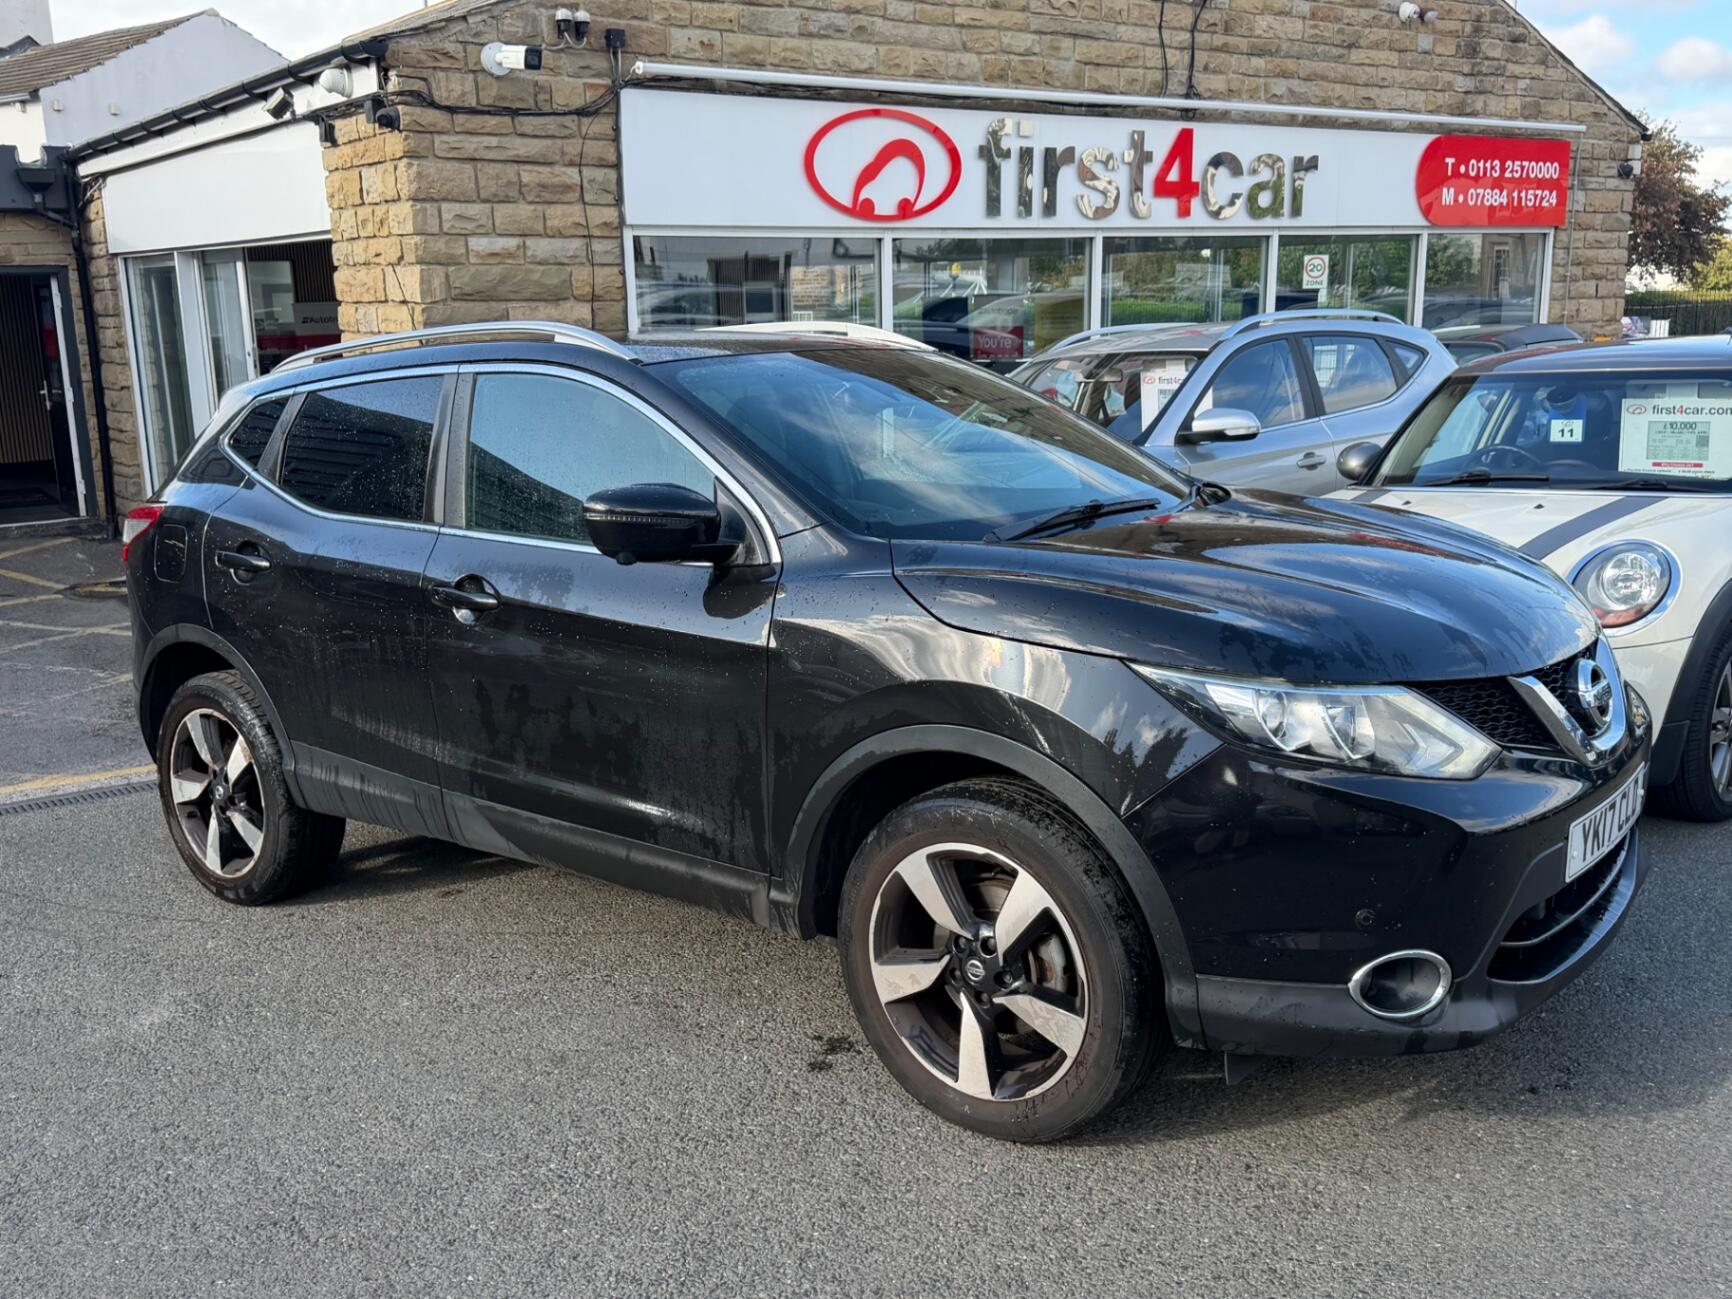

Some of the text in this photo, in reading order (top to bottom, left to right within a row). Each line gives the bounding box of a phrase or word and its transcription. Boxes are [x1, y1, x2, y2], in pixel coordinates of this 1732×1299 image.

[978, 117, 1319, 221] first4car
[1445, 157, 1560, 179] T 0113 2570000
[1442, 187, 1557, 207] M 07884 115724
[1308, 263, 1323, 273] 20
[1557, 428, 1574, 438] 11
[1582, 805, 1616, 862] YK17
